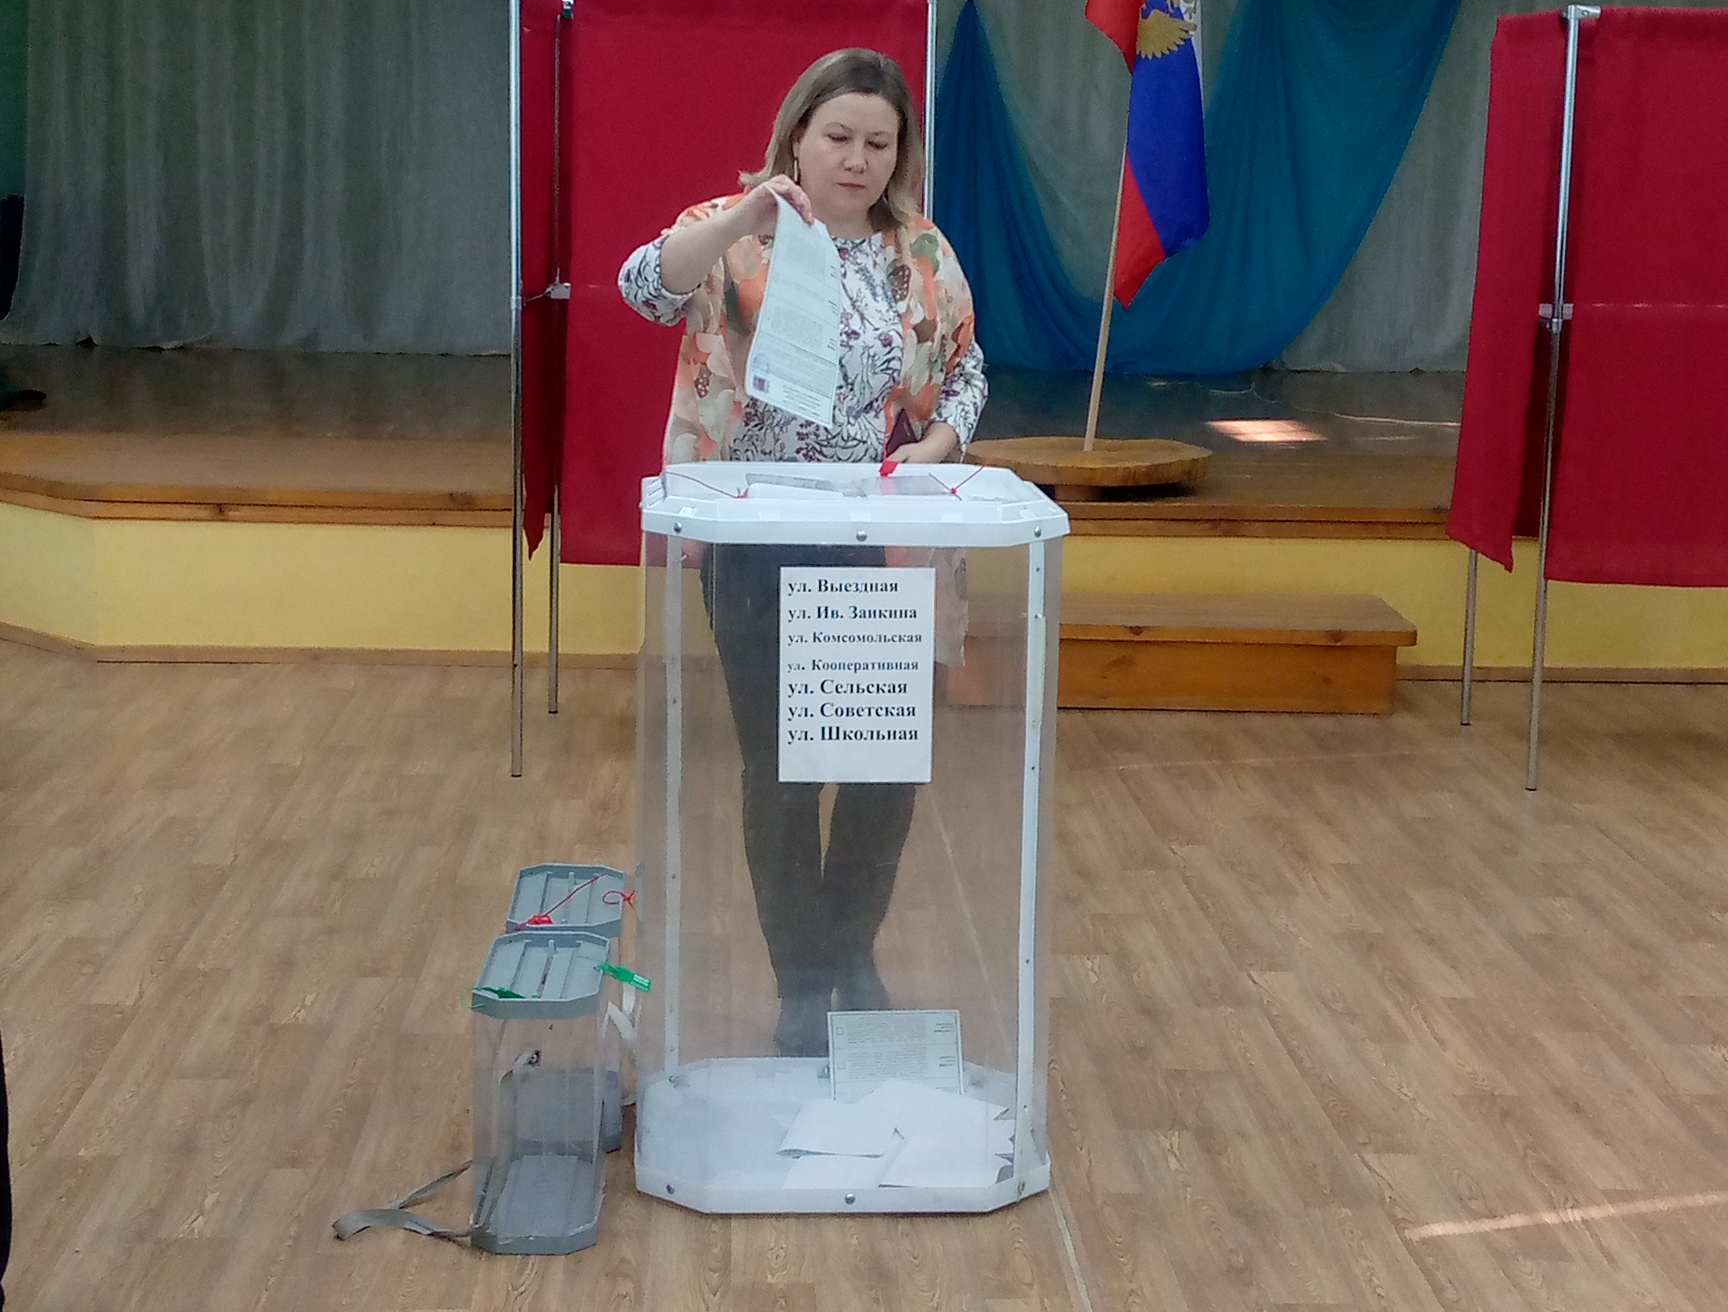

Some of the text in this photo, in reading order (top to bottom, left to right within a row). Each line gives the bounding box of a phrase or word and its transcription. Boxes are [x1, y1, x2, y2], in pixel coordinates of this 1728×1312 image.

[788, 578, 898, 596] ул. Выездная
[788, 609, 811, 623] ул.
[817, 605, 844, 619] Ив.
[788, 631, 922, 646] ул. Комсомольская
[787, 659, 919, 674] ул. Кооперативная
[787, 679, 907, 699] ул. Сельская
[787, 702, 916, 722] ул. Советская
[787, 726, 918, 745] ул. Школьная
